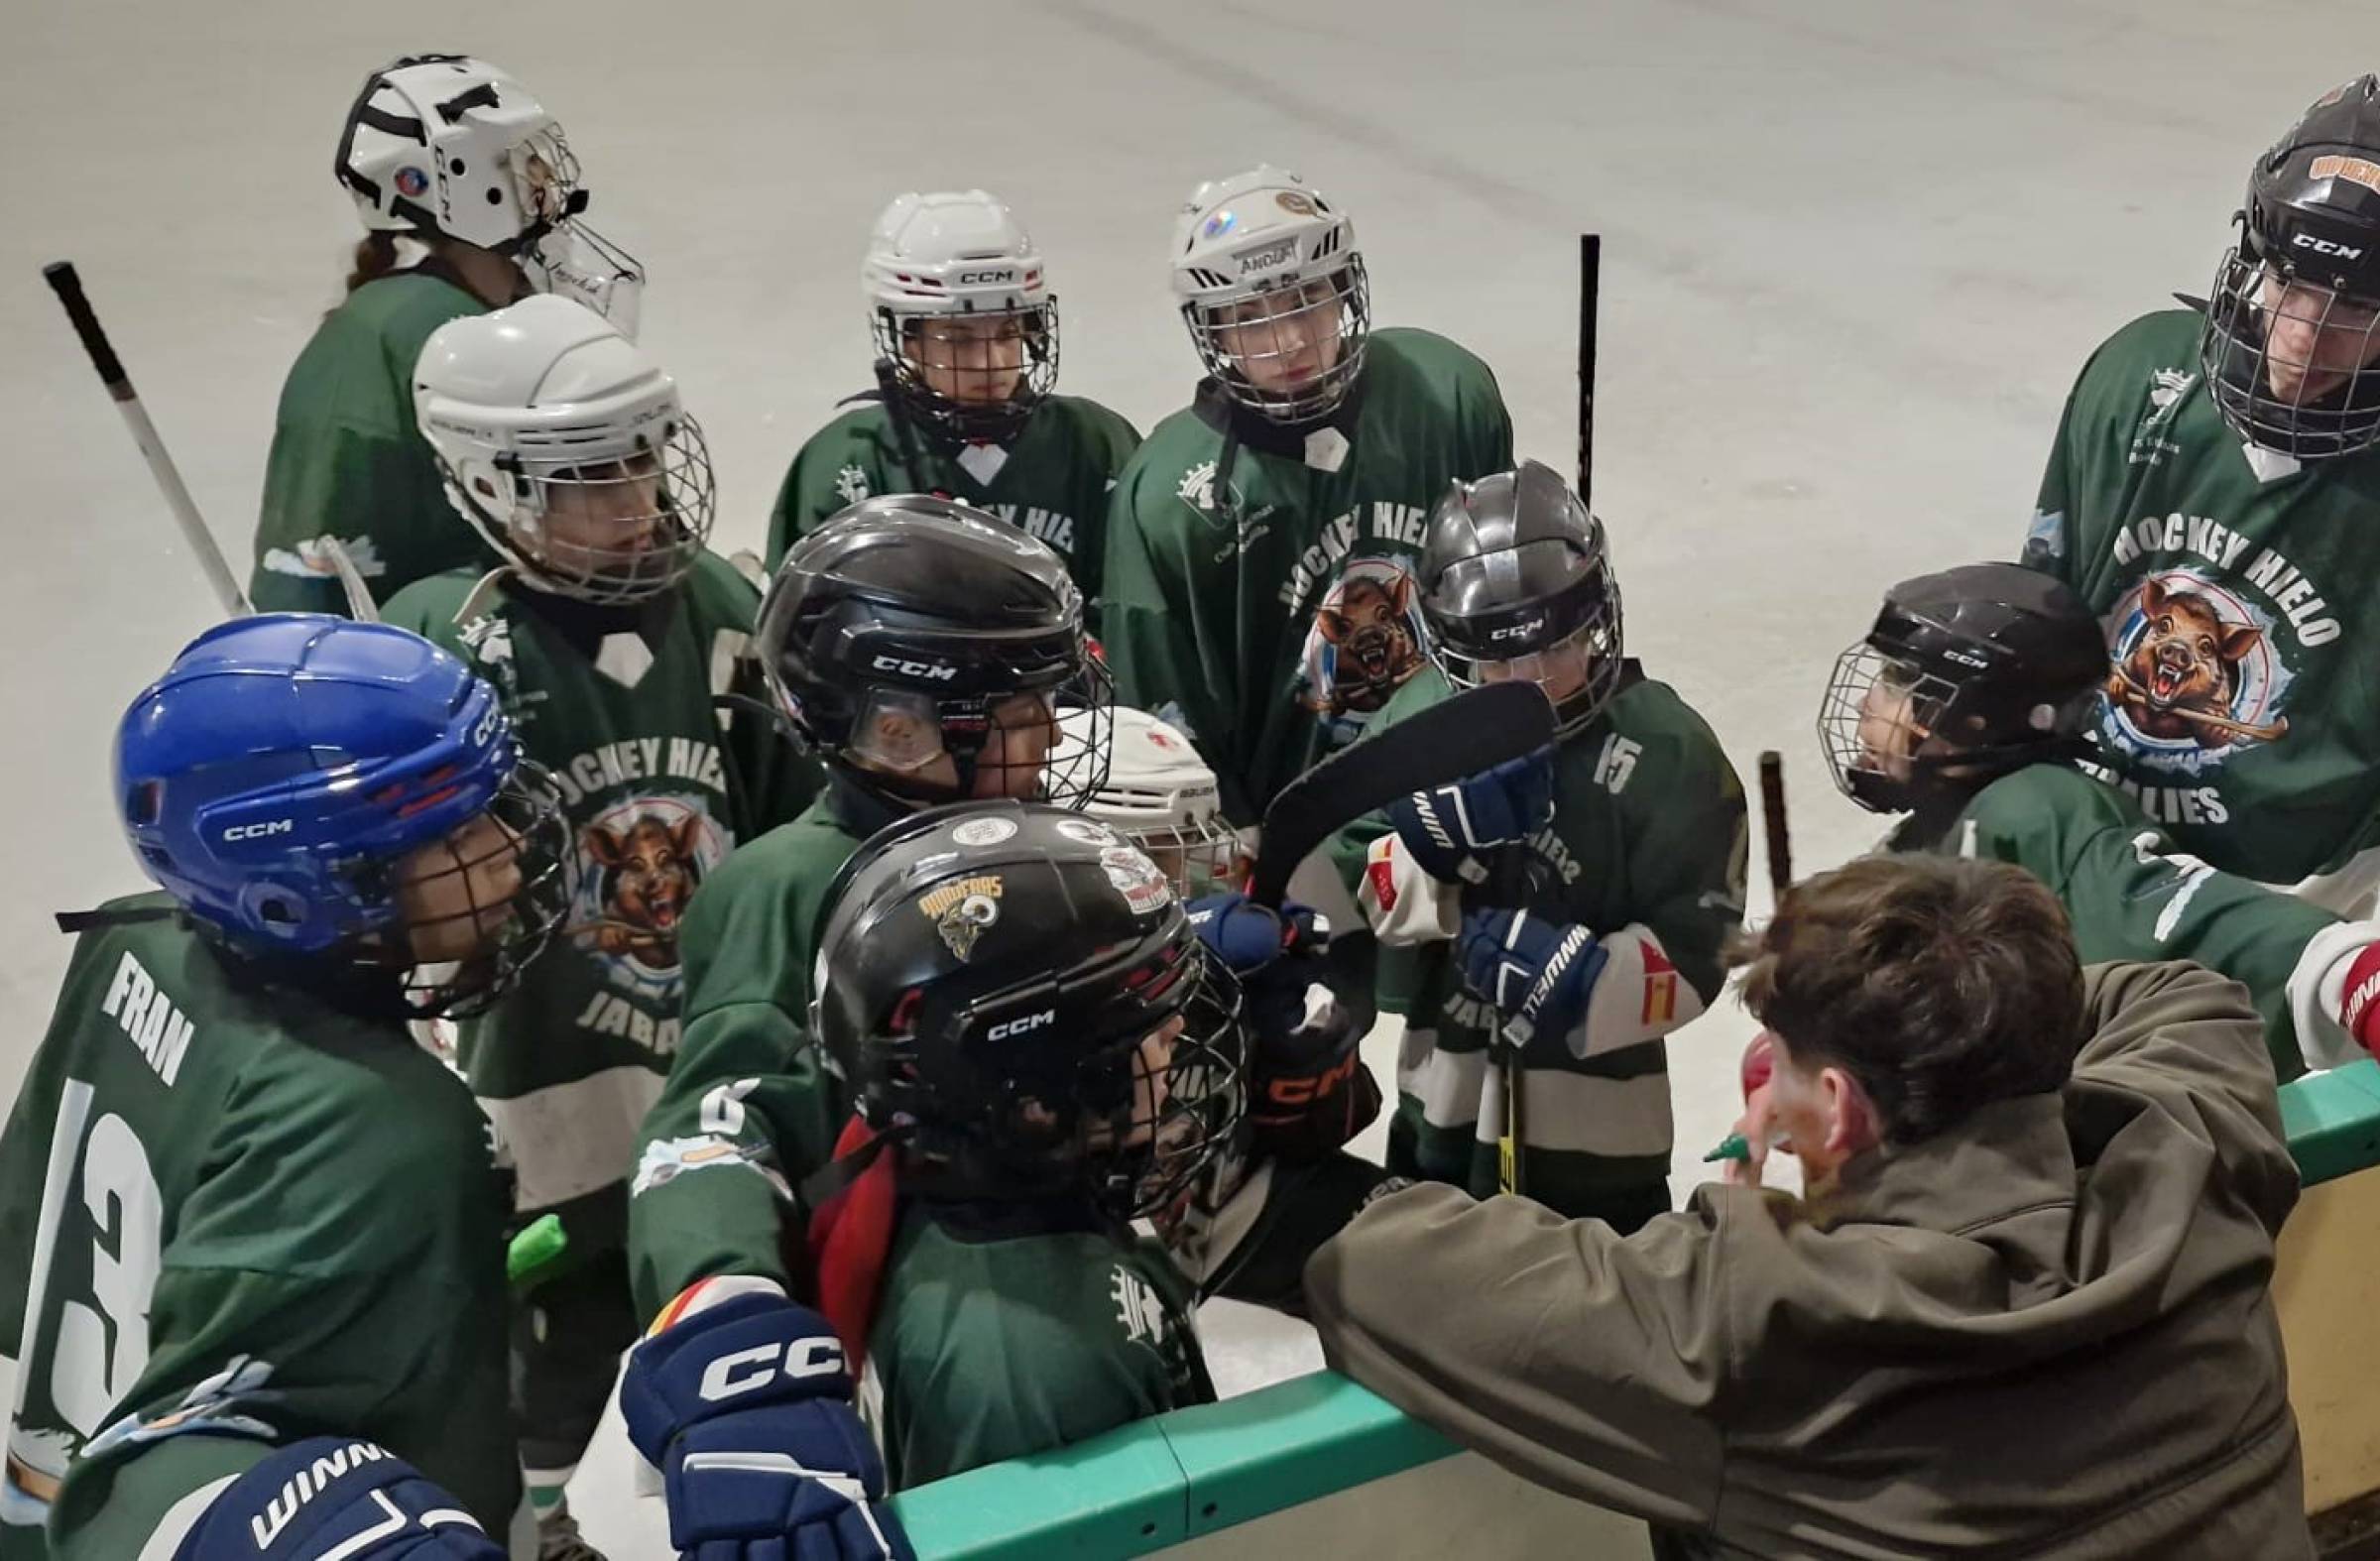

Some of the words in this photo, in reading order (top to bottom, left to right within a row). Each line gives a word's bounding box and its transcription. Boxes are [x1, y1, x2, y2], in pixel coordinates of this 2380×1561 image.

[2293, 232, 2364, 260] CCM
[961, 270, 1013, 285] CCM
[2113, 513, 2251, 569] HOCKEY
[2242, 547, 2341, 647] HIELO
[1490, 619, 1546, 641] CCM
[873, 655, 959, 680] CCM
[1944, 650, 1988, 668] CCM
[1593, 733, 1643, 794] 15
[225, 818, 294, 842] CCM
[102, 950, 194, 1088] FRAN
[988, 1009, 1055, 1041] CCM
[699, 1077, 762, 1135] 6
[12, 1077, 163, 1440] 13
[699, 1336, 853, 1401] CC
[251, 1443, 397, 1550] WINN
